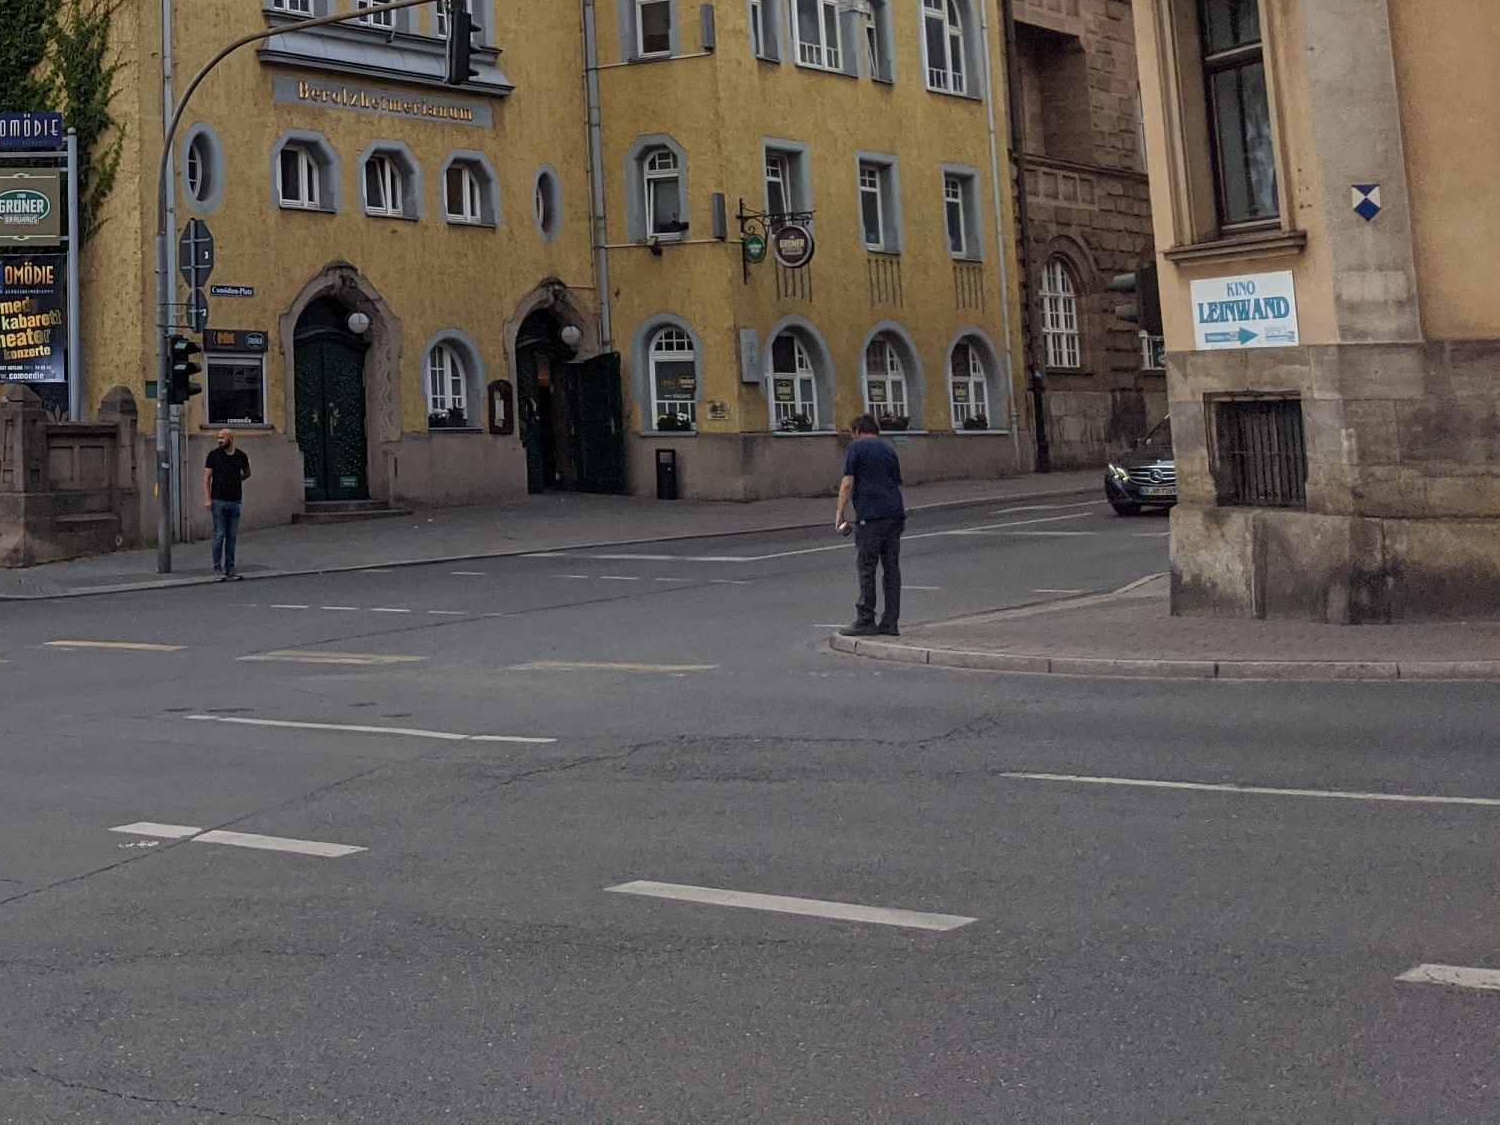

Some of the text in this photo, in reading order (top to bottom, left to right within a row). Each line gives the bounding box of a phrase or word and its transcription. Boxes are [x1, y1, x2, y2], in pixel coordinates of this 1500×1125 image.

[298, 80, 474, 121] Berolzheimerianum
[1226, 280, 1256, 297] KINO
[1, 309, 62, 330] kabarett
[1197, 296, 1290, 324] LEINWAND
